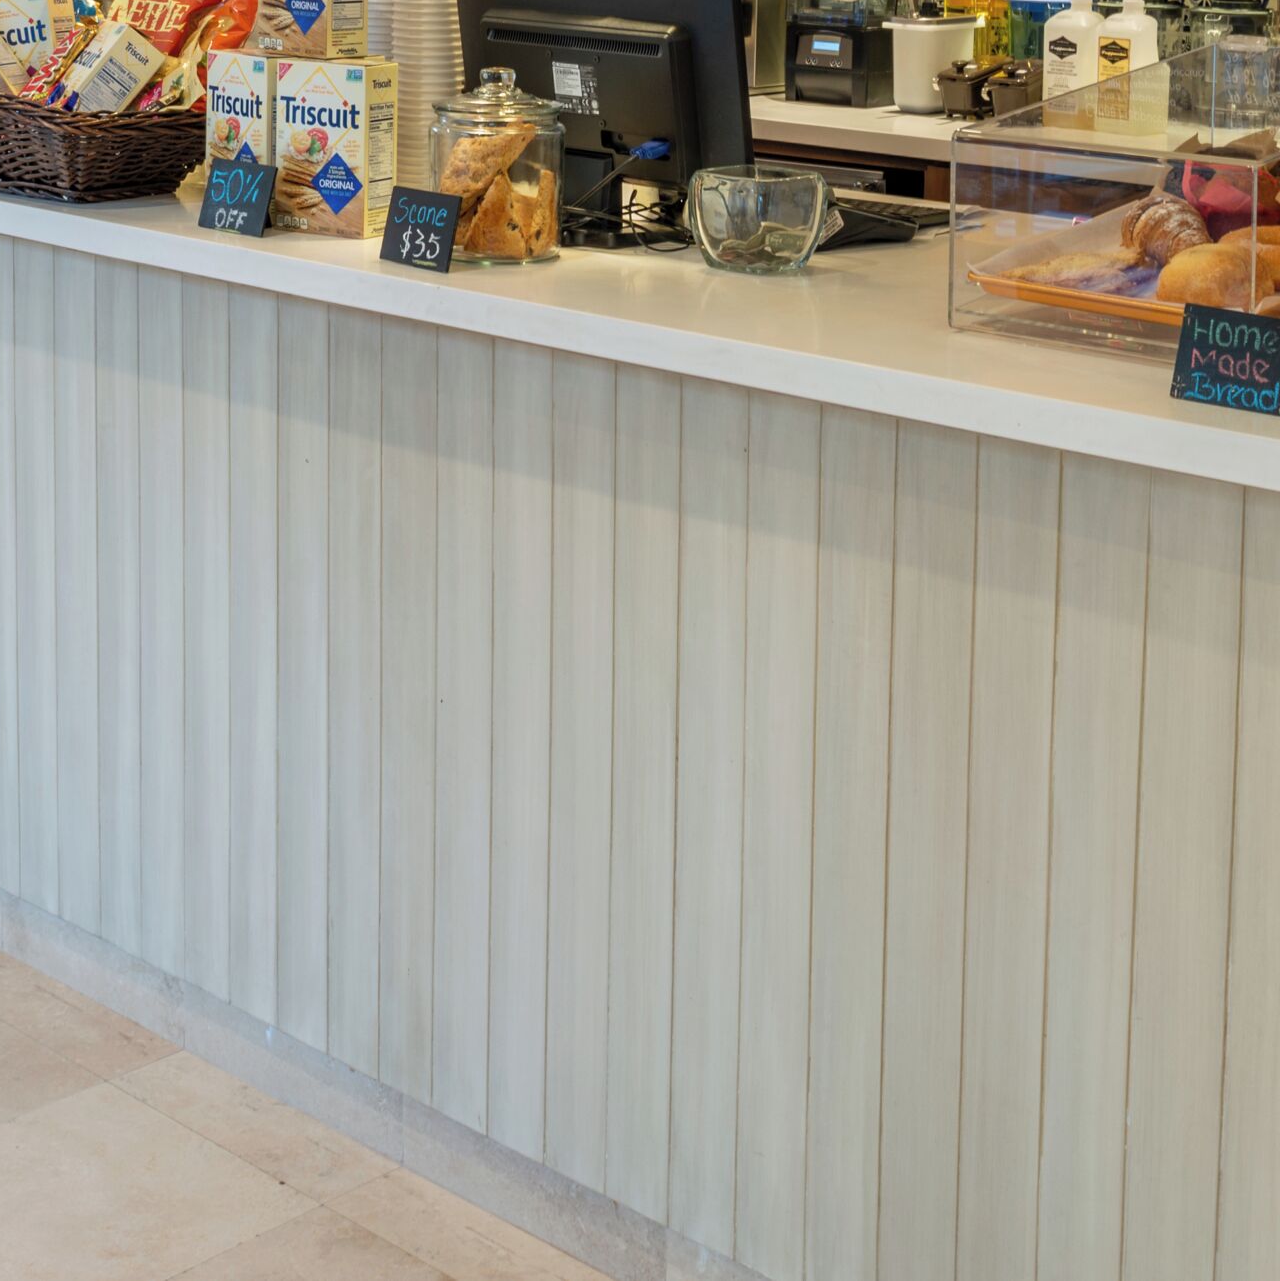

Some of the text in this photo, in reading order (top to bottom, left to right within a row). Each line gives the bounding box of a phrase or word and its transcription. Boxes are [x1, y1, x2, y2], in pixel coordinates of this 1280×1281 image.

[291, 0, 319, 11] ORIGINAL
[125, 41, 150, 66] Triscuit
[373, 79, 391, 89] Triscuit
[209, 85, 262, 119] Triscuit
[280, 96, 360, 129] Triscuit
[211, 168, 264, 204] 50%
[319, 179, 355, 191] ORIGINAL
[215, 208, 247, 229] OFF
[395, 196, 448, 227] Scone
[400, 225, 440, 259] $35
[1194, 318, 1279, 354] Home
[1191, 348, 1270, 383] Made
[1185, 372, 1280, 412] Bread
